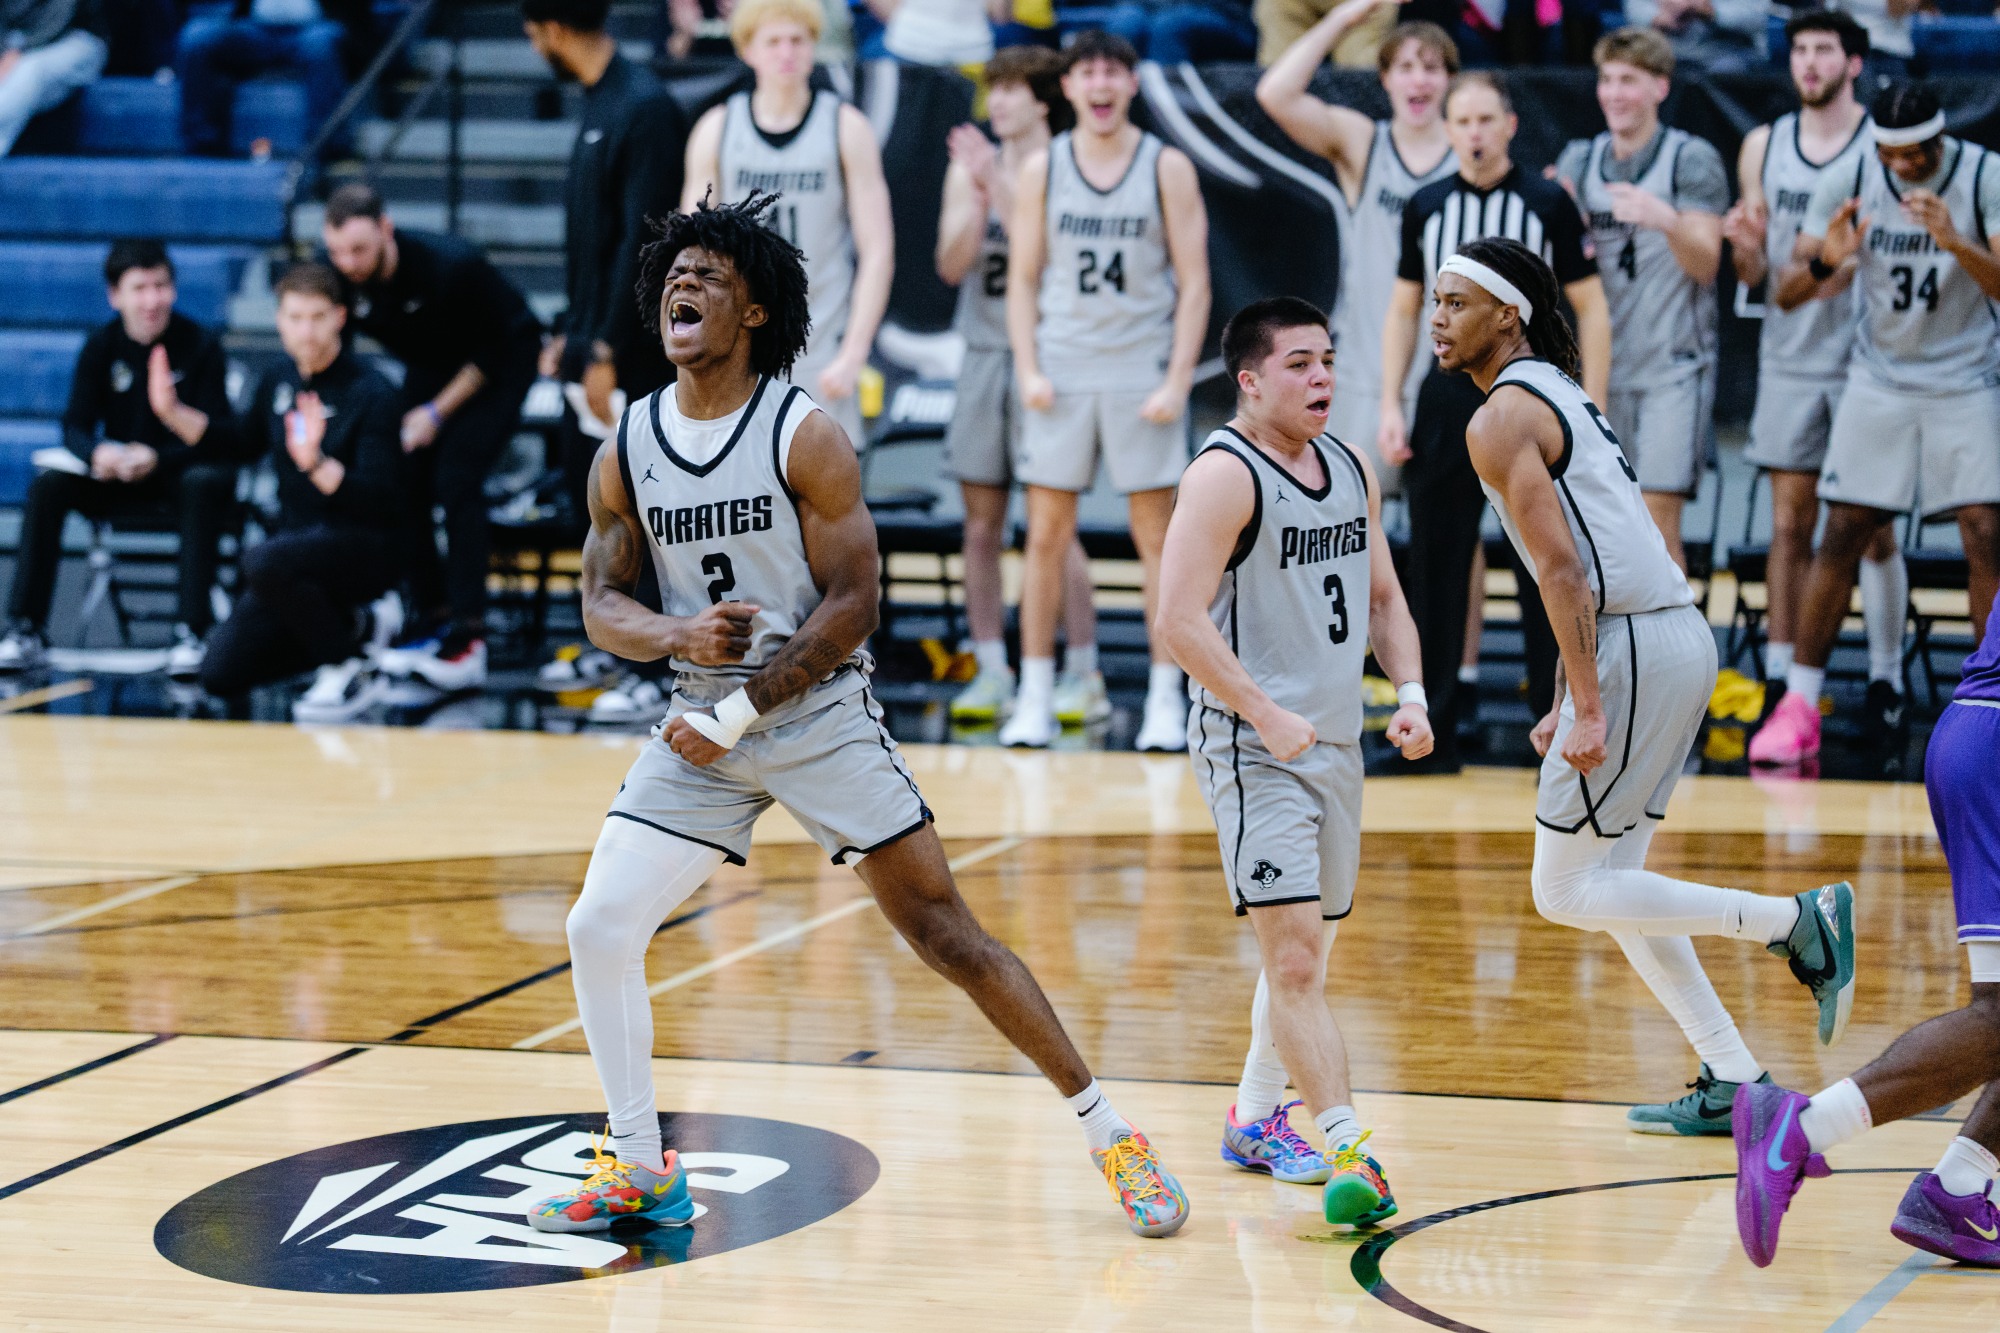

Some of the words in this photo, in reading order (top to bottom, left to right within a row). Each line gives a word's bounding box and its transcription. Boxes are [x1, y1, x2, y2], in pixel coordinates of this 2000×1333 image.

[1078, 249, 1125, 293] 24
[1617, 236, 1637, 280] 4
[1890, 265, 1940, 312] 34
[647, 495, 773, 547] PIRATES
[1280, 516, 1367, 569] PIRATES
[701, 552, 740, 606] 2
[1323, 573, 1349, 645] 3
